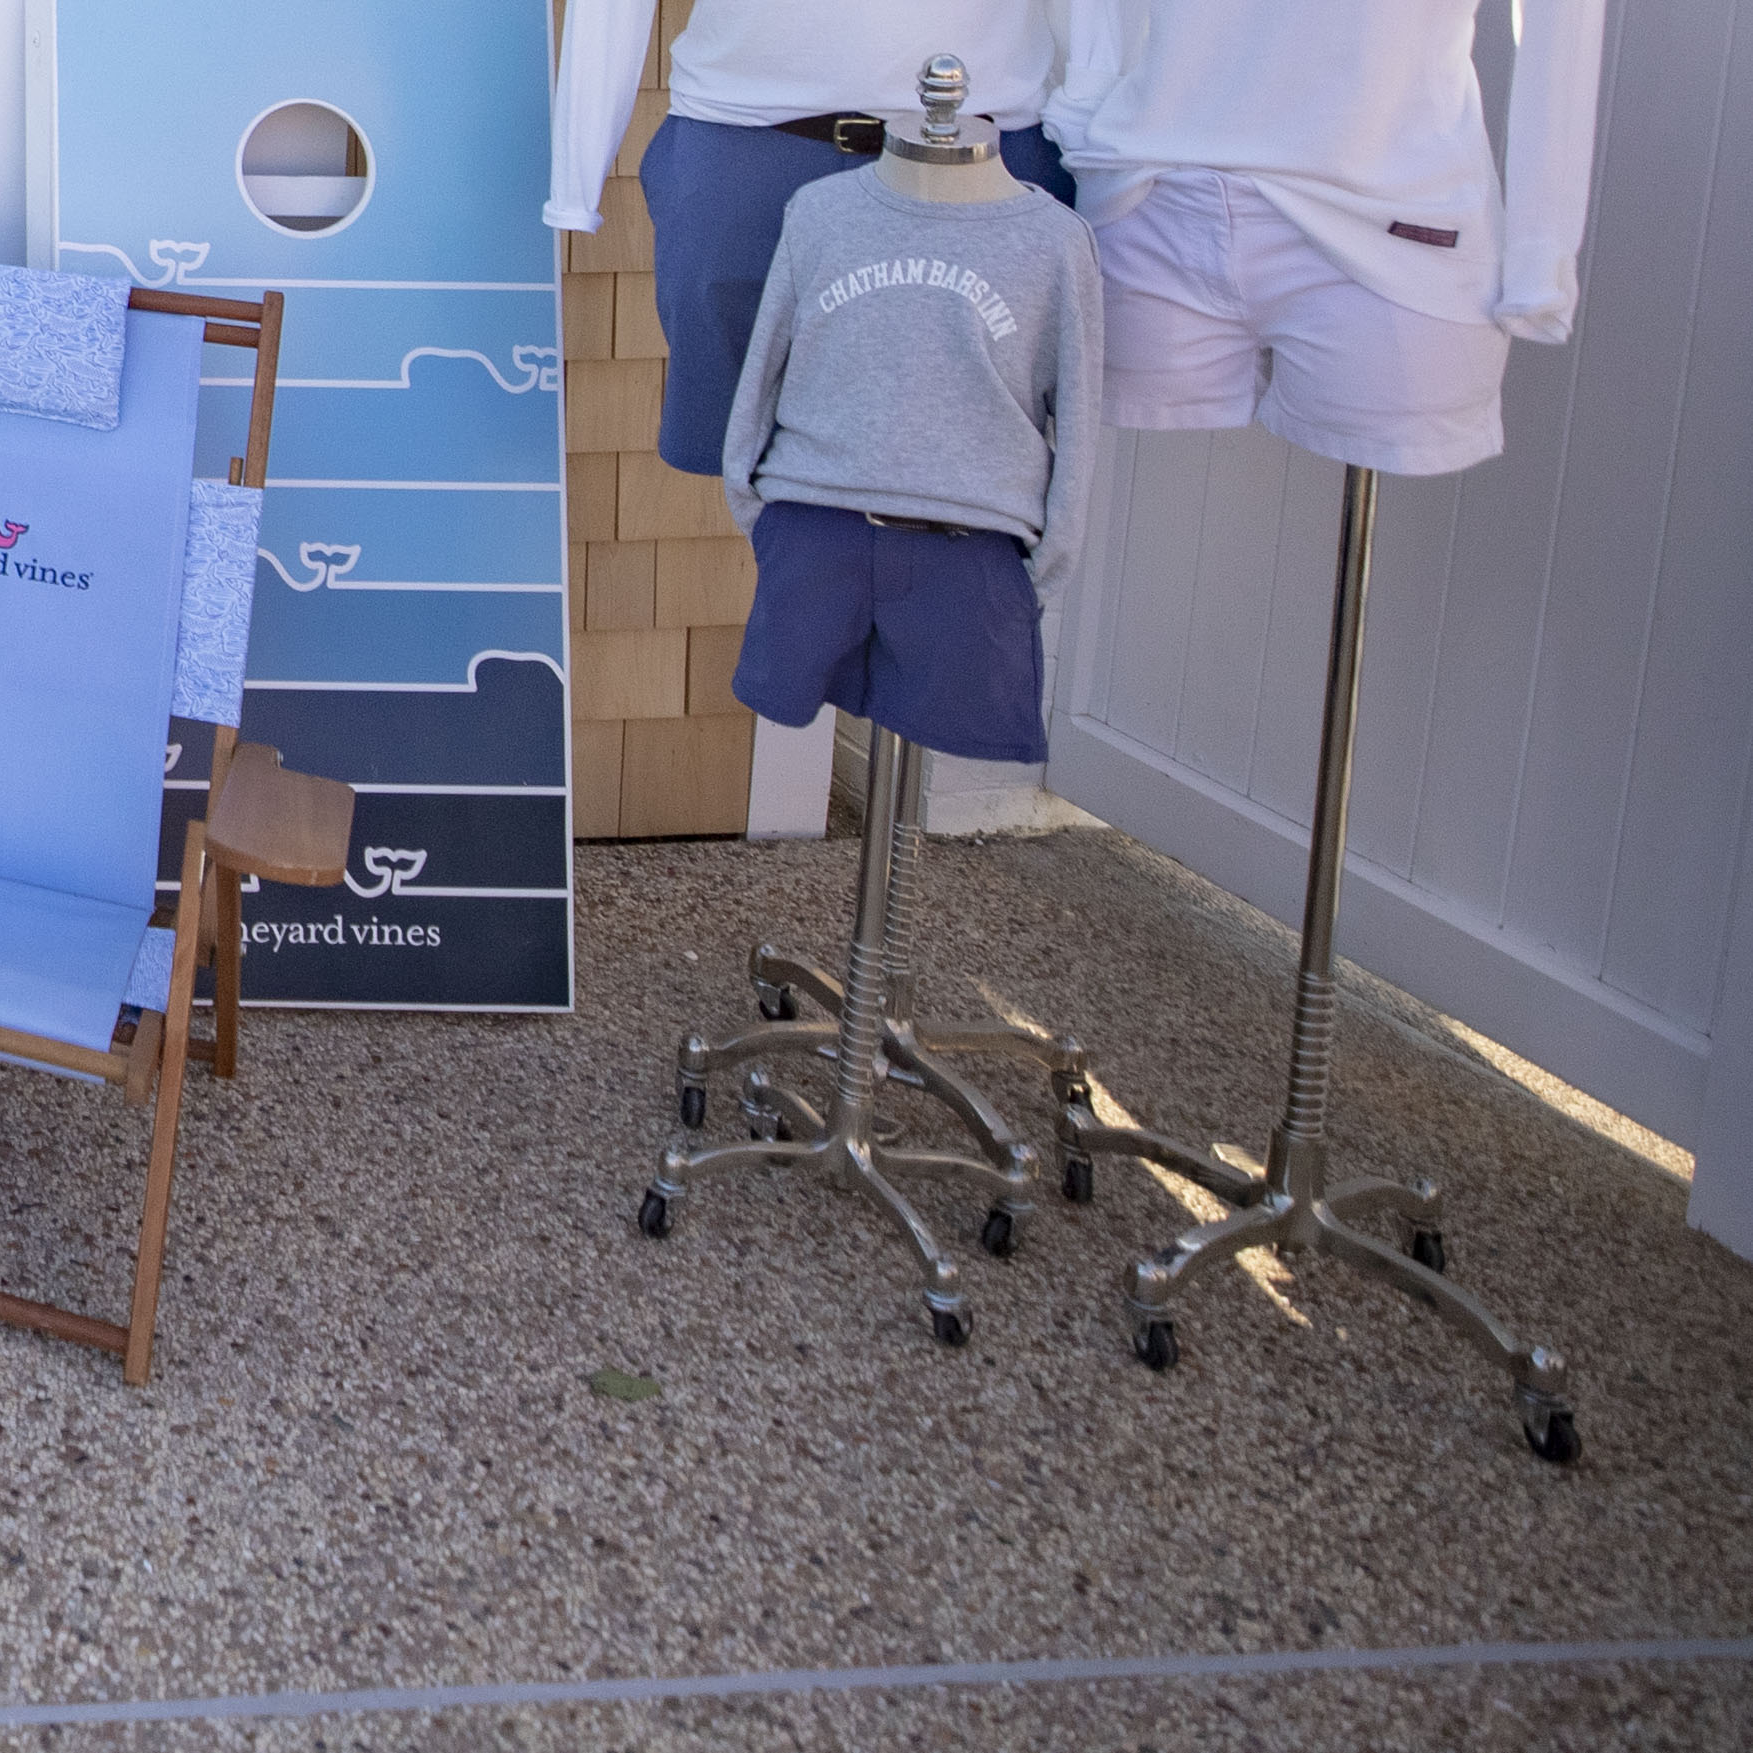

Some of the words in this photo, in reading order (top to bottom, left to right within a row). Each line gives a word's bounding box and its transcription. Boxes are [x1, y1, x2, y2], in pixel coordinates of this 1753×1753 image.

[818, 258, 927, 313] CHATHAM
[927, 259, 990, 305] BARS
[977, 292, 1018, 342] INN
[14, 558, 92, 591] vines
[350, 915, 442, 947] vines
